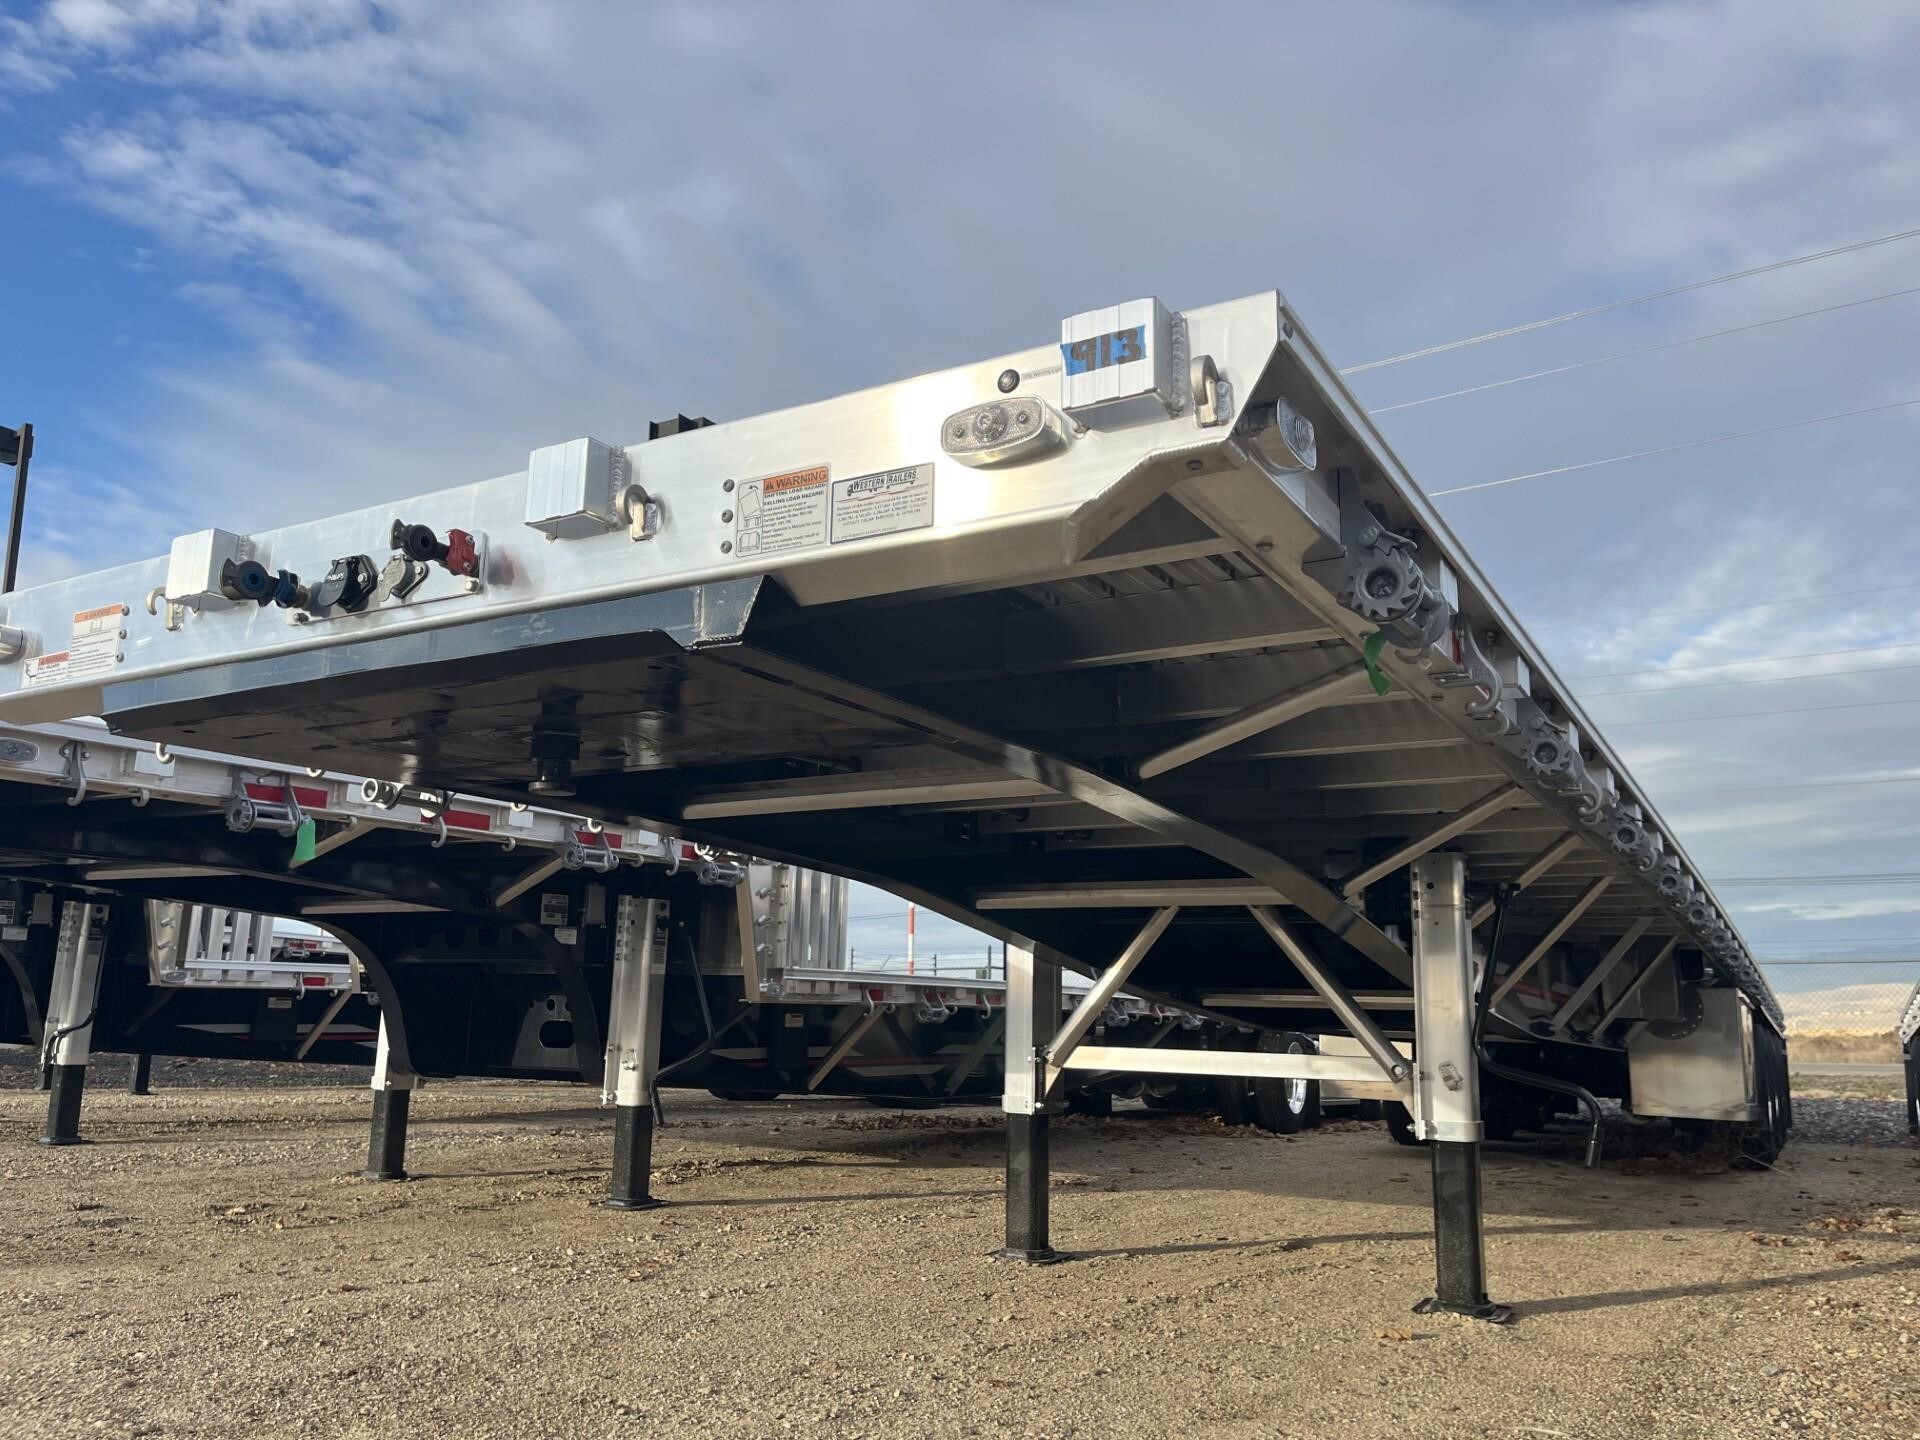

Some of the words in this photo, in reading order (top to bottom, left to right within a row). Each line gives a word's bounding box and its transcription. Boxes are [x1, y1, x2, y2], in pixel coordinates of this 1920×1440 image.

[1071, 327, 1141, 371] 913
[776, 470, 826, 488] WARNING
[853, 477, 885, 490] WESTERN
[886, 470, 917, 484] TRAILERS
